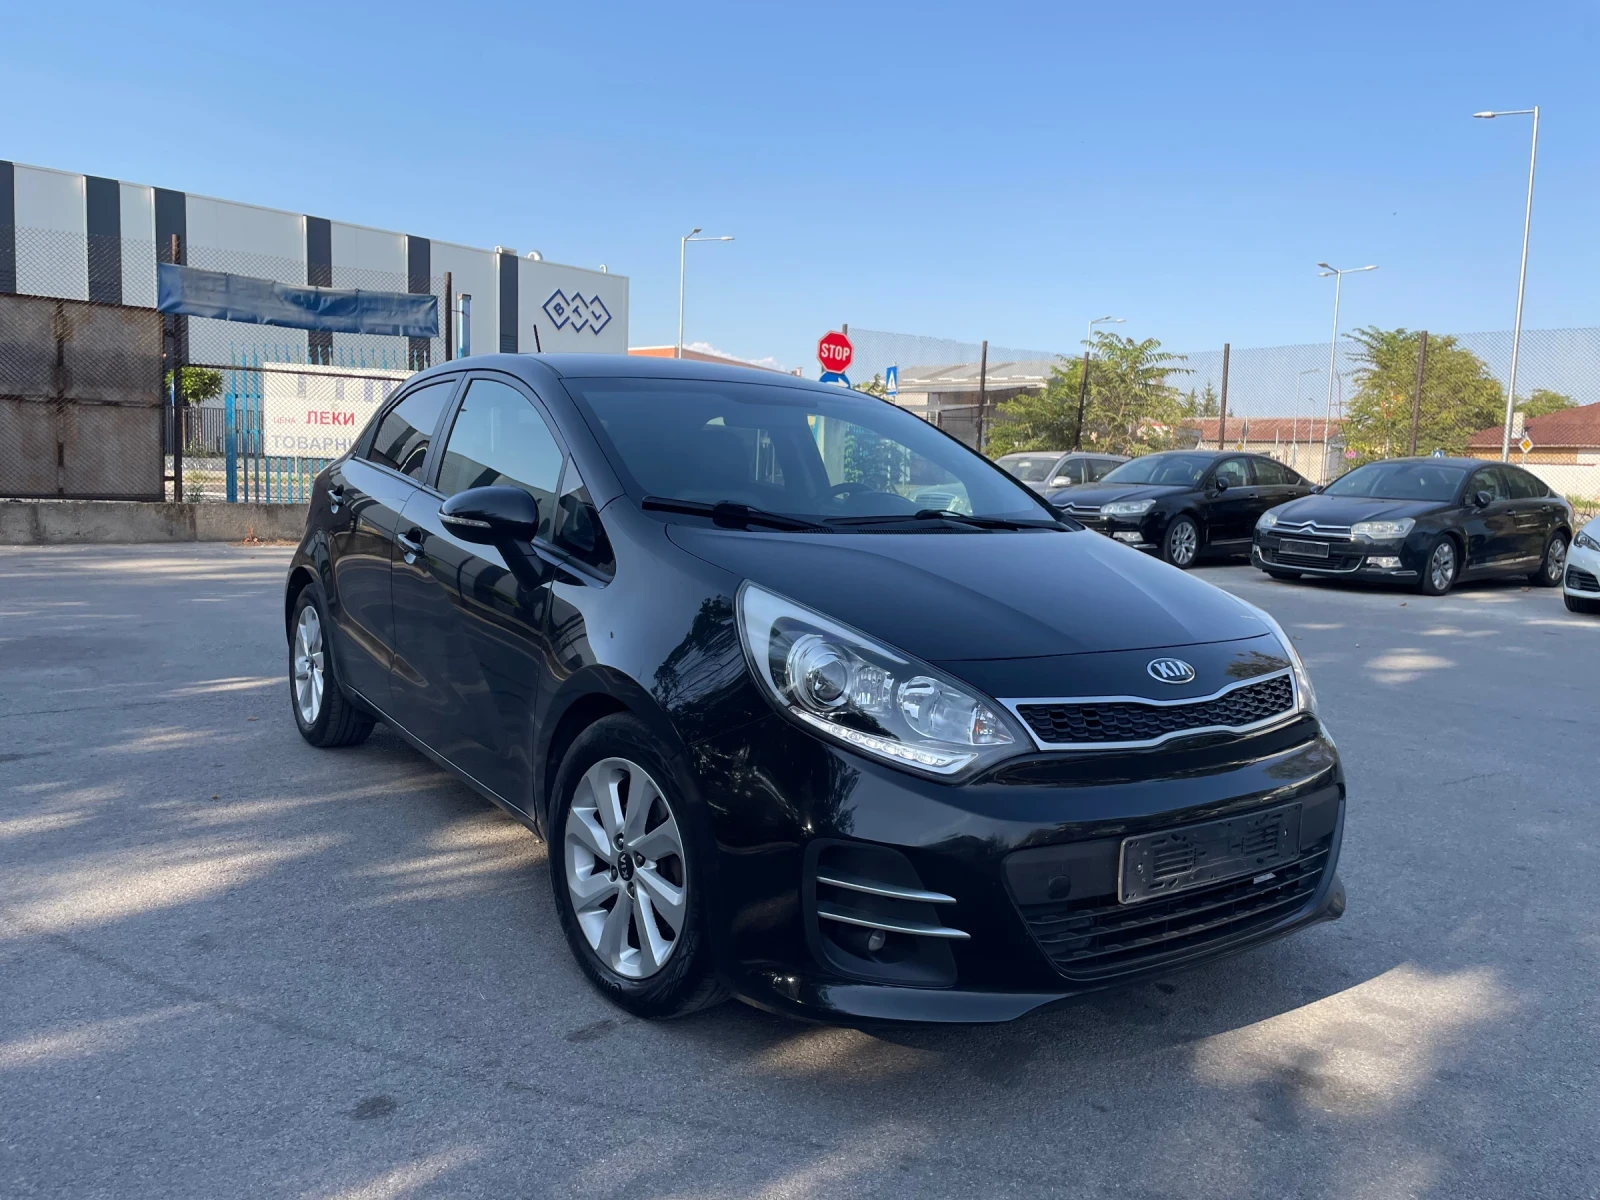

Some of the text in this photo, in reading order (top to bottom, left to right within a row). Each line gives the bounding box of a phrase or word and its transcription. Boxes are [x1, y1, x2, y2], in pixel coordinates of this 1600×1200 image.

[553, 302, 602, 321] BTL
[820, 343, 851, 361] STOP
[305, 410, 355, 426] ЛЕКИ
[1153, 661, 1192, 678] KIA
[620, 853, 629, 879] KIA
